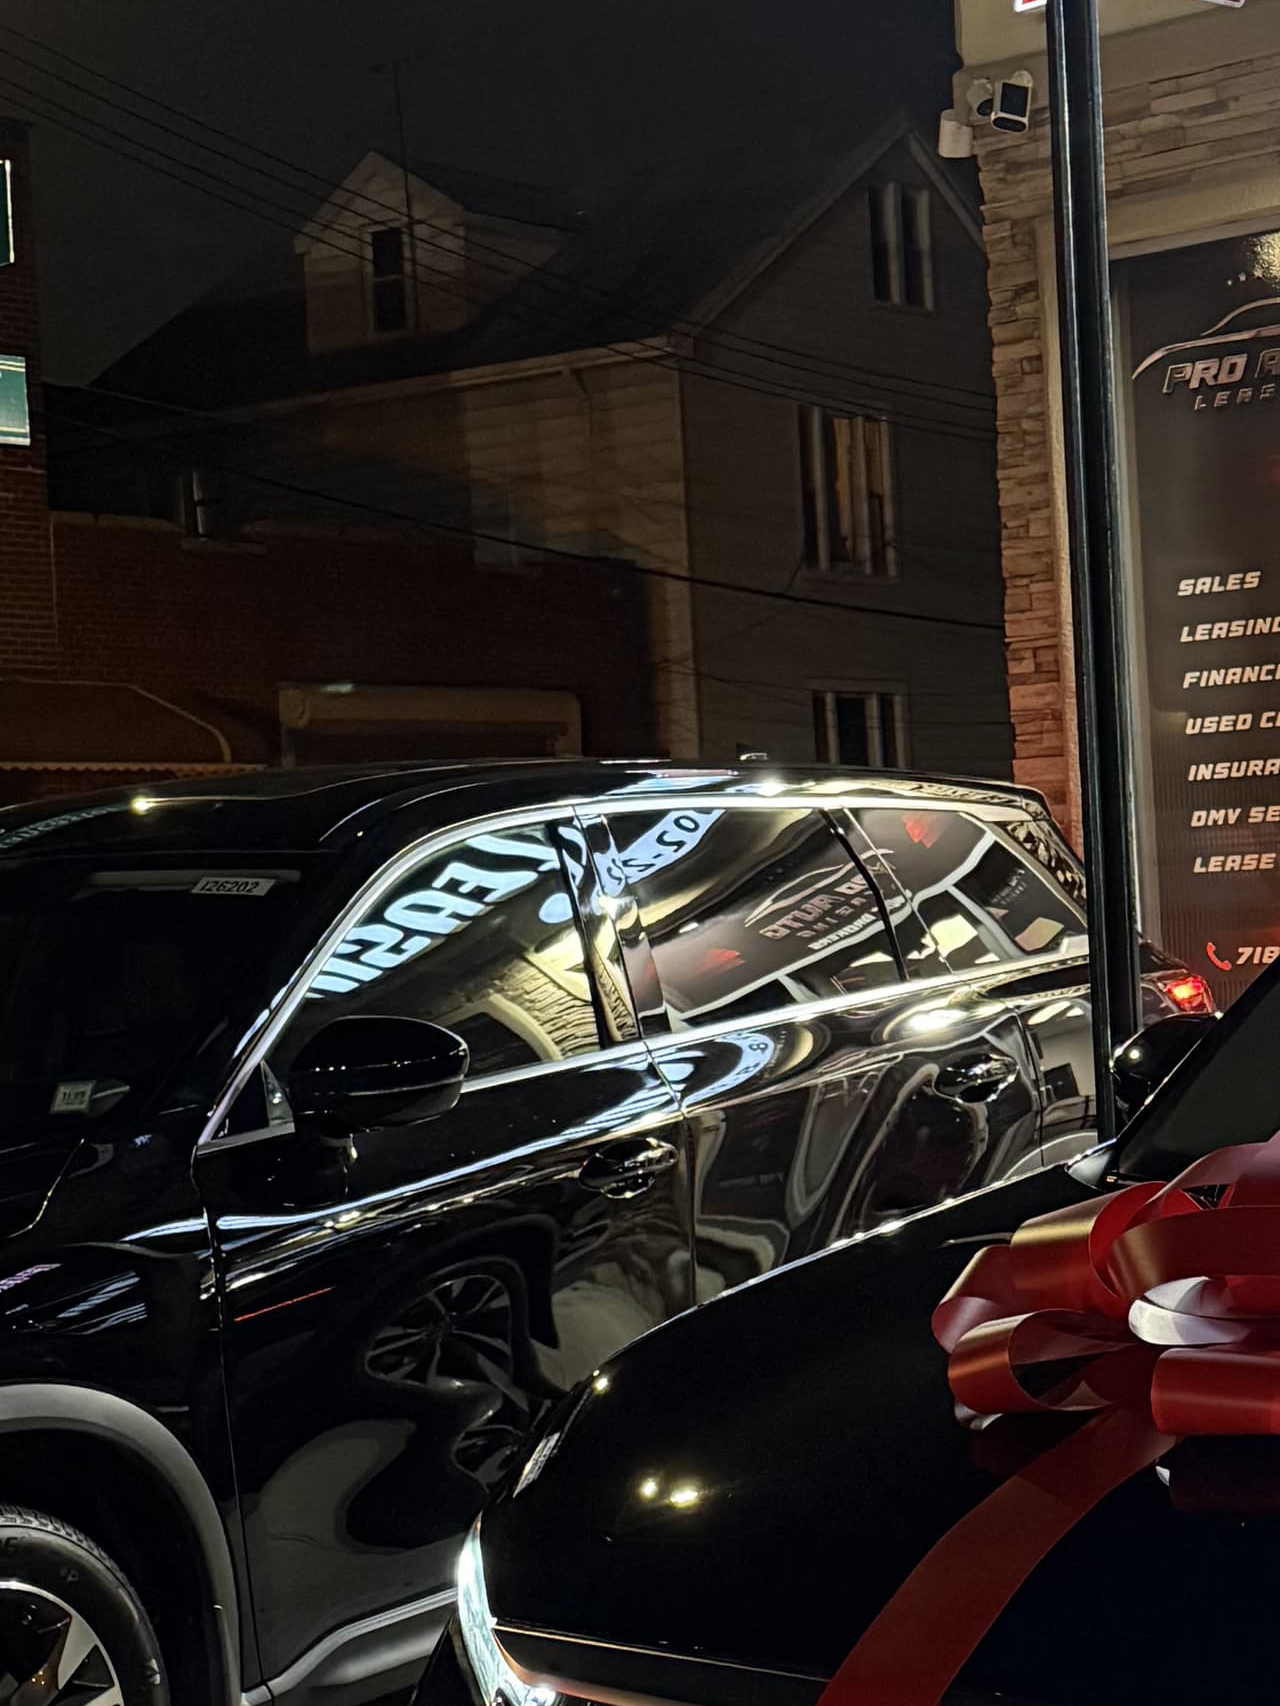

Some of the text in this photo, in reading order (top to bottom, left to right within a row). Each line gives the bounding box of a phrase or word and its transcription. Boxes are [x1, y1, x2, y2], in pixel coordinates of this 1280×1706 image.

[1162, 353, 1248, 394] PRO
[1177, 571, 1261, 596] SALES
[1185, 713, 1253, 735] USED
[1190, 807, 1242, 827] DMV
[1193, 853, 1276, 873] LEASE
